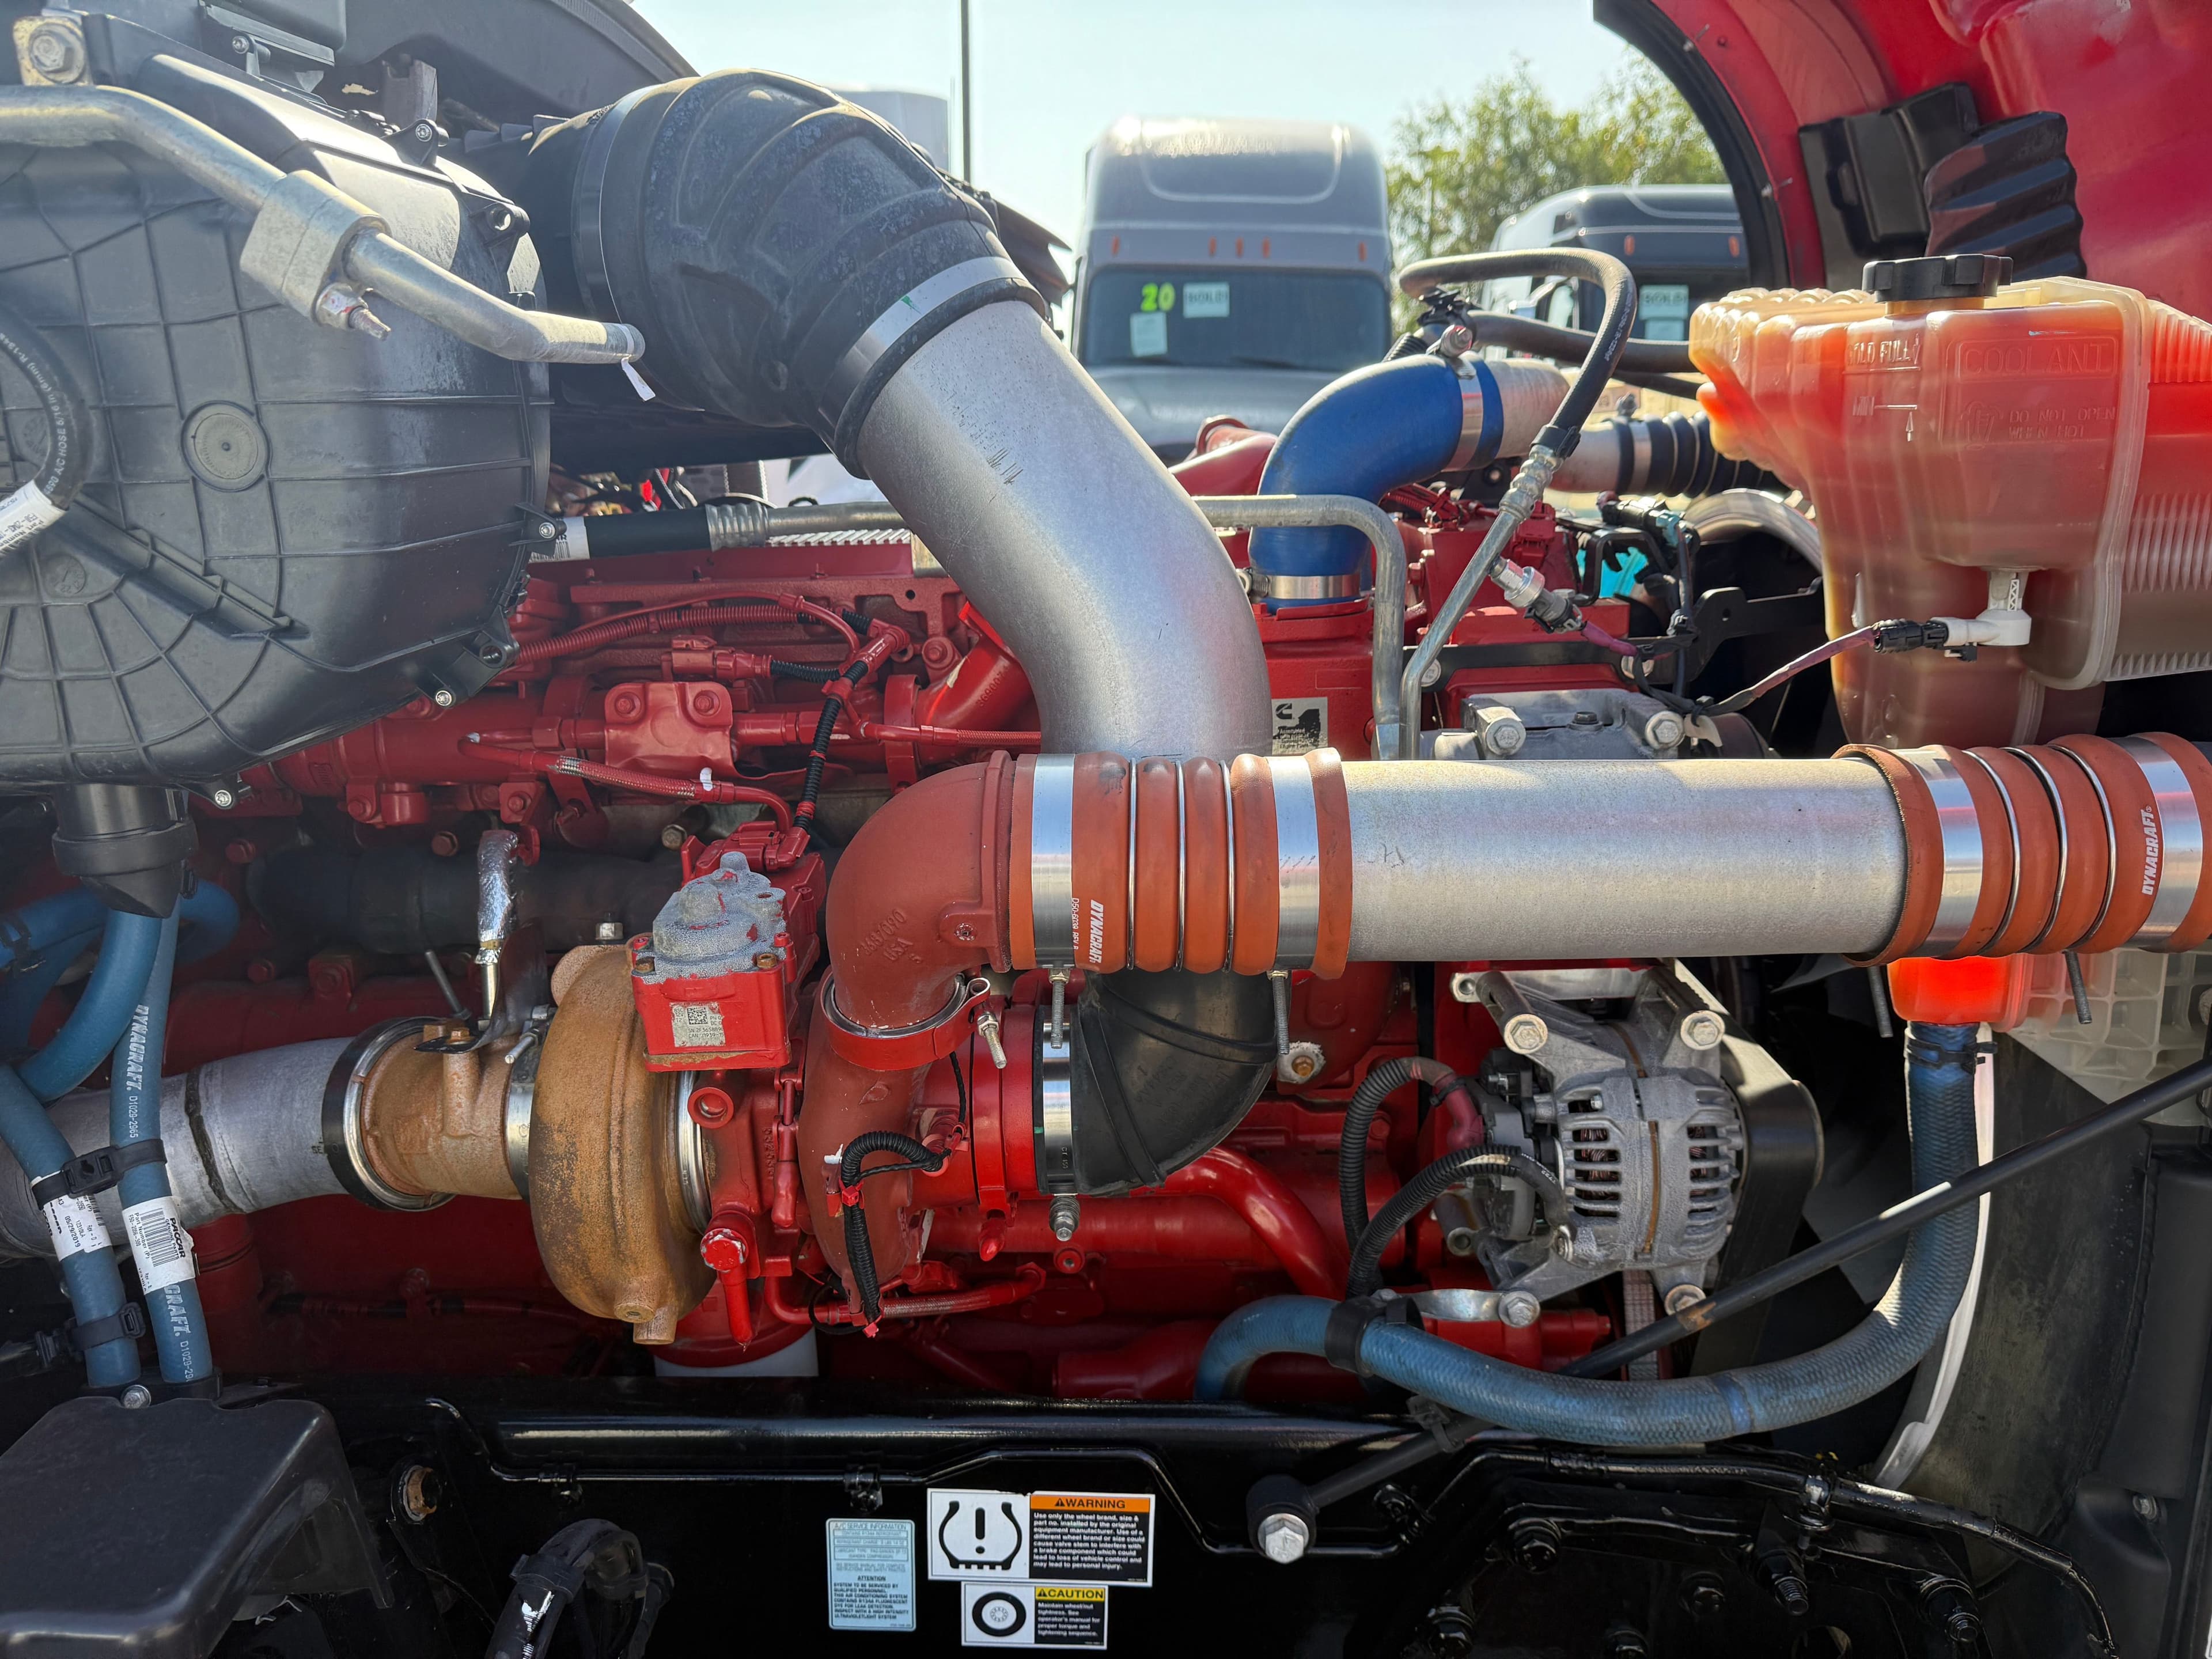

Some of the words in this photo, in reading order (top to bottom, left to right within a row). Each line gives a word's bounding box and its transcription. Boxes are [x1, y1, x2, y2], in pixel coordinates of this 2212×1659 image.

[1140, 282, 1175, 312] 20
[1965, 344, 2111, 374] COOLANT
[2009, 410, 2029, 423] DO
[2037, 409, 2066, 422] NOT
[2077, 407, 2116, 420] OPEN
[56, 428, 67, 456] HOSE
[2056, 425, 2084, 438] HOT
[54, 458, 66, 474] A/C
[26, 520, 44, 531] Part
[129, 1096, 138, 1138] D1029-2965
[64, 1215, 81, 1248] 05/29/2019
[138, 1226, 147, 1249] Number
[165, 1218, 175, 1242] GENUINE
[172, 1243, 180, 1260] PARTS
[170, 1217, 186, 1259] PACCAR
[179, 1340, 195, 1382] D1029-29
[1066, 1498, 1125, 1508] WARNING
[1048, 1589, 1103, 1599] CAUTION
